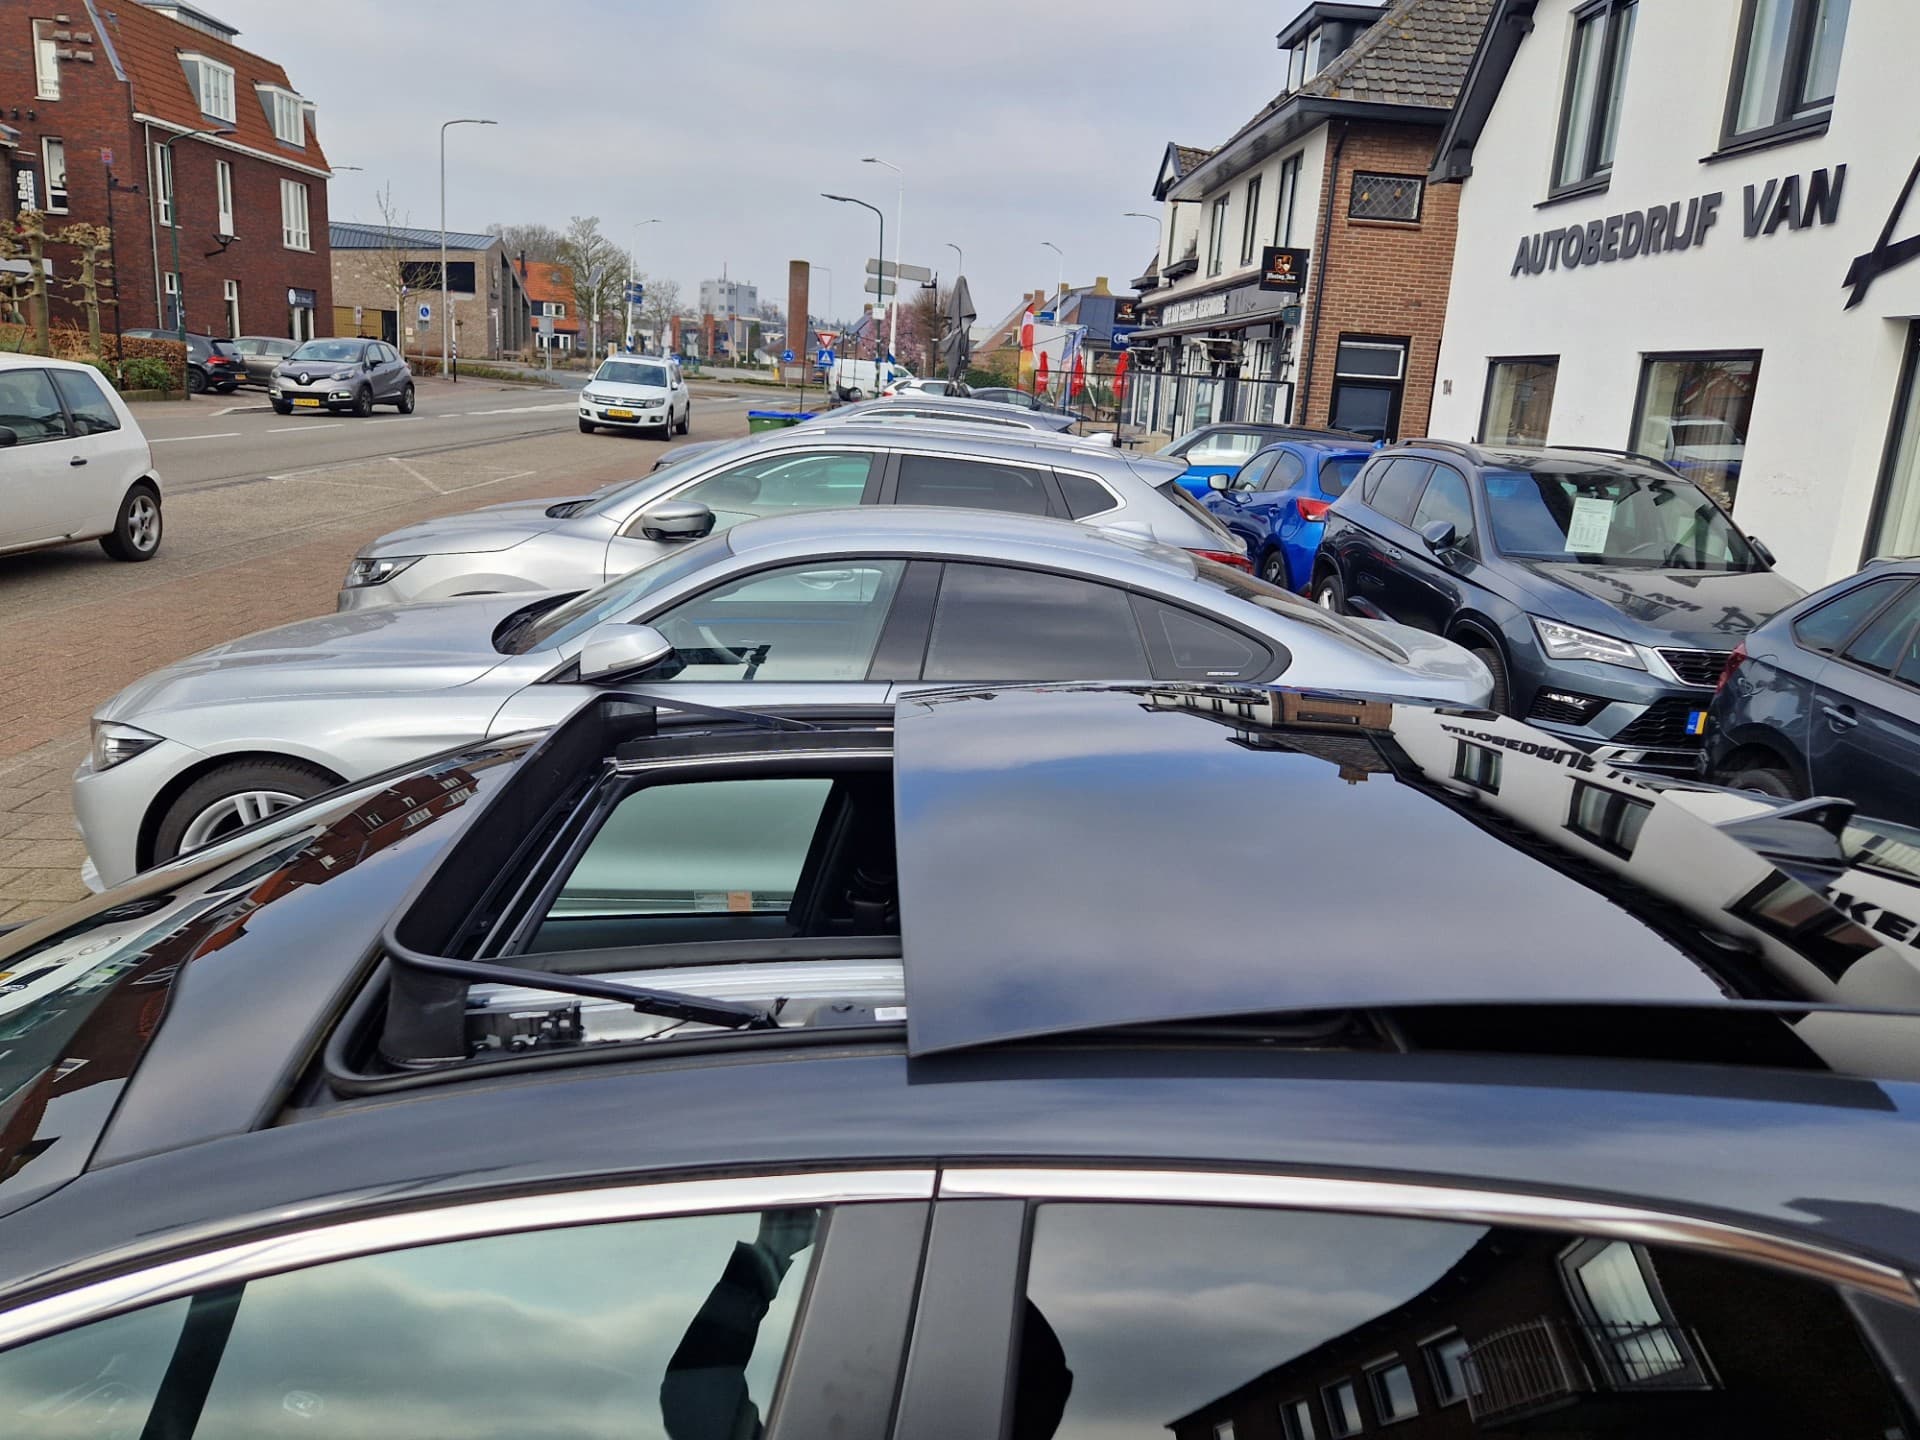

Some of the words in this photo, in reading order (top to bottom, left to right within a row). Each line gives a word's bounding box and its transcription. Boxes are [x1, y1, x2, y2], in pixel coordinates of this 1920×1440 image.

[17, 170, 29, 200] Belle
[1510, 191, 1723, 277] AUTOBEDRIJF
[1743, 163, 1847, 239] VAN
